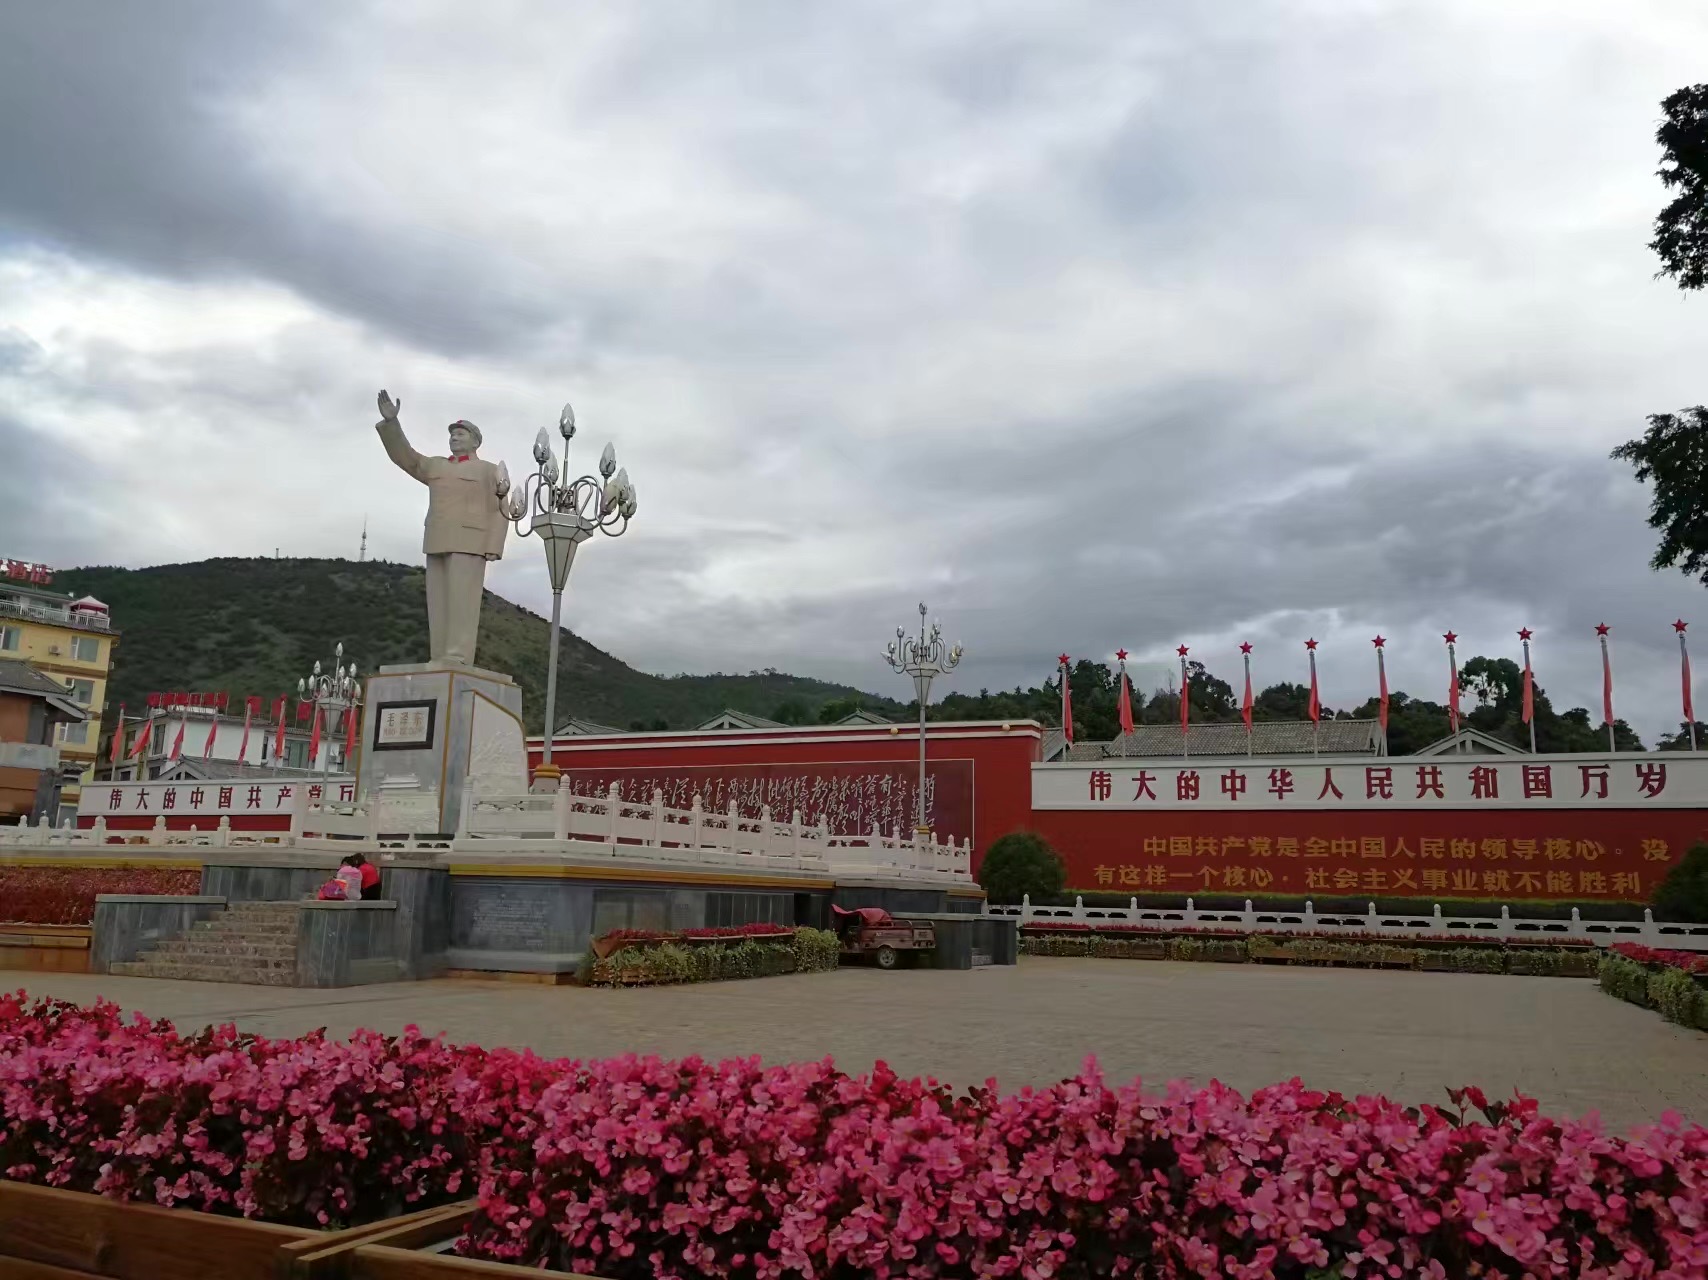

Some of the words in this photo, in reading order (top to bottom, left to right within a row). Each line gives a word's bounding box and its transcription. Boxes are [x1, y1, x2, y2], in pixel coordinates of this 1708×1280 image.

[1089, 764, 1666, 801] 伟大的中华人民共和国万岁
